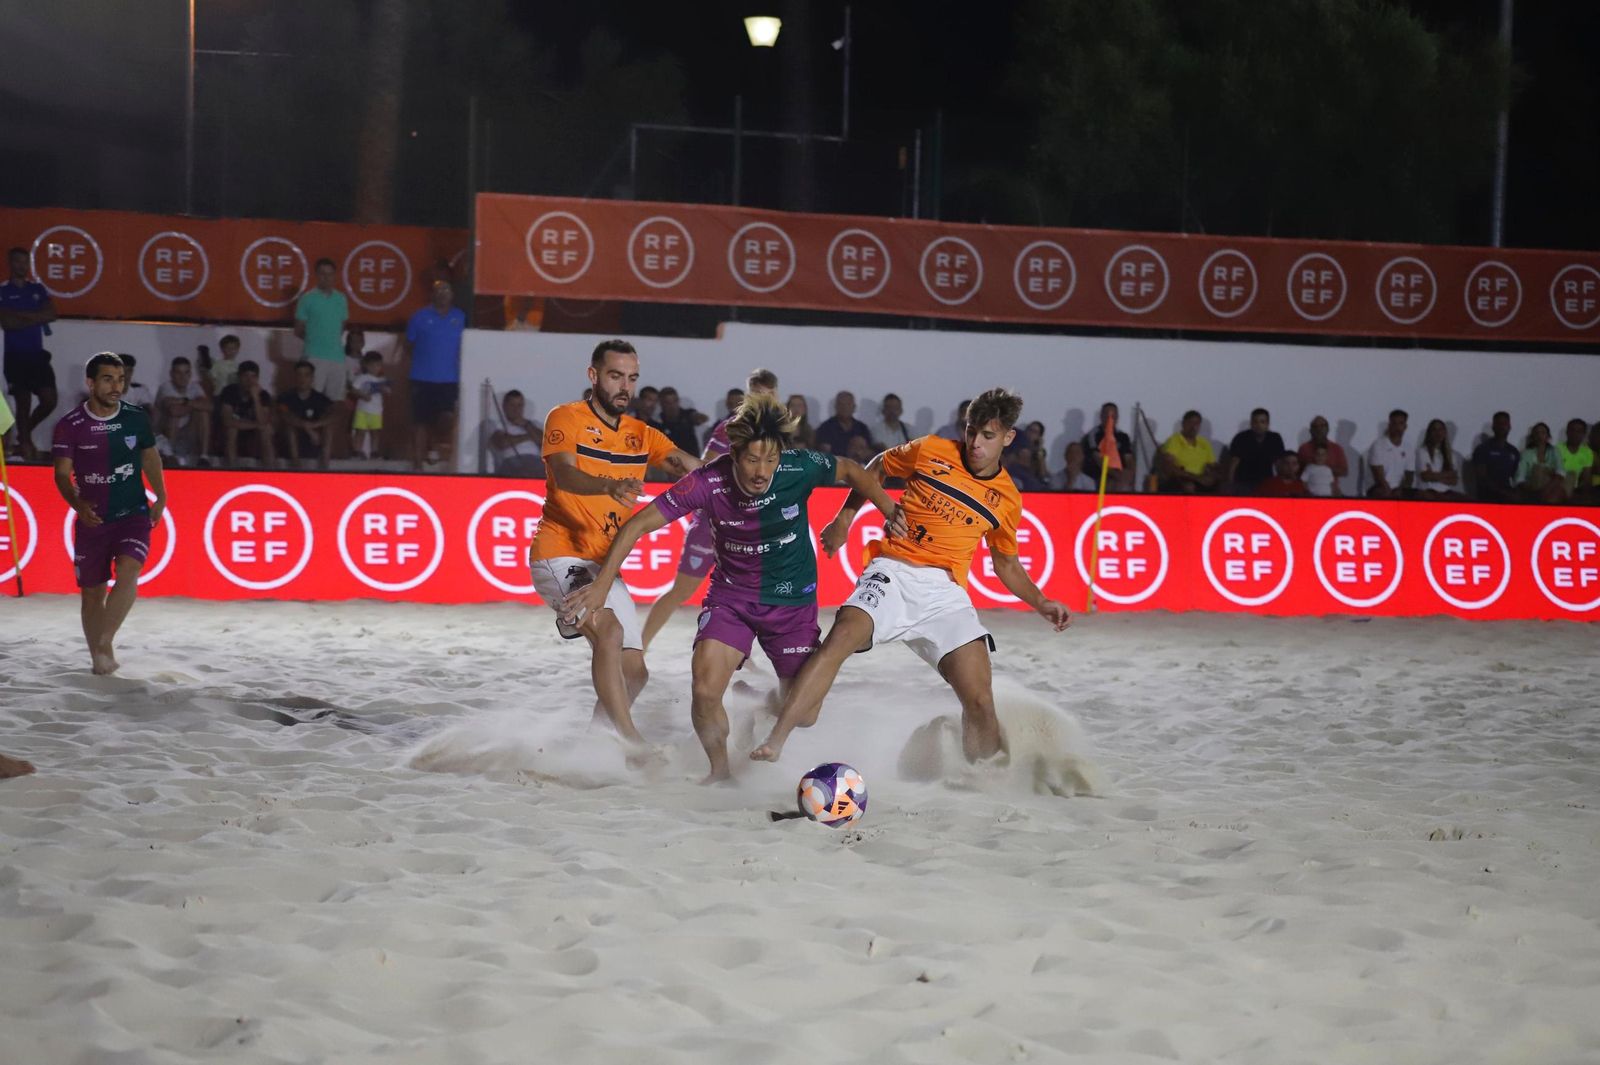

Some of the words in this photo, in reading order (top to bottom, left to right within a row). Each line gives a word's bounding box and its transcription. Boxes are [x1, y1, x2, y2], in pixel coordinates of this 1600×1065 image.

[542, 228, 578, 245] RF
[644, 233, 679, 250] RF
[47, 242, 85, 259] RF
[745, 239, 780, 254] RF
[842, 245, 875, 261] RF
[156, 248, 193, 264] RF
[257, 254, 292, 269] RF
[542, 249, 578, 265] EF
[643, 254, 679, 270] EF
[935, 252, 968, 268] RF
[47, 263, 86, 279] EF
[360, 258, 395, 274] RF
[744, 258, 781, 275] EF
[842, 265, 875, 280] EF
[1029, 257, 1062, 273] RF
[1121, 261, 1155, 278] RF
[1214, 265, 1245, 281] RF
[156, 268, 193, 283] EF
[257, 274, 292, 289] EF
[935, 272, 968, 287] EF
[1302, 269, 1333, 285] RF
[1391, 273, 1423, 288] RF
[360, 278, 394, 293] EF
[1028, 277, 1062, 292] EF
[1120, 281, 1154, 297] EF
[1212, 285, 1244, 300] EF
[1478, 278, 1509, 292] RF
[1564, 281, 1595, 294] RF
[1301, 288, 1333, 304] EF
[1390, 292, 1422, 307] EF
[1476, 296, 1508, 311] EF
[1564, 299, 1595, 313] EF
[231, 511, 287, 534] RF
[363, 513, 419, 536] RF
[1096, 530, 1145, 553] RF
[1223, 533, 1271, 555] RF
[1334, 535, 1381, 557] RF
[1443, 537, 1490, 559] RF
[231, 540, 288, 563] EF
[364, 542, 420, 565] EF
[1551, 540, 1597, 562] RF
[1098, 557, 1147, 580] EF
[1225, 559, 1272, 582] EF
[1336, 562, 1383, 584] EF
[1445, 564, 1492, 586] EF
[1553, 566, 1599, 589] EF
